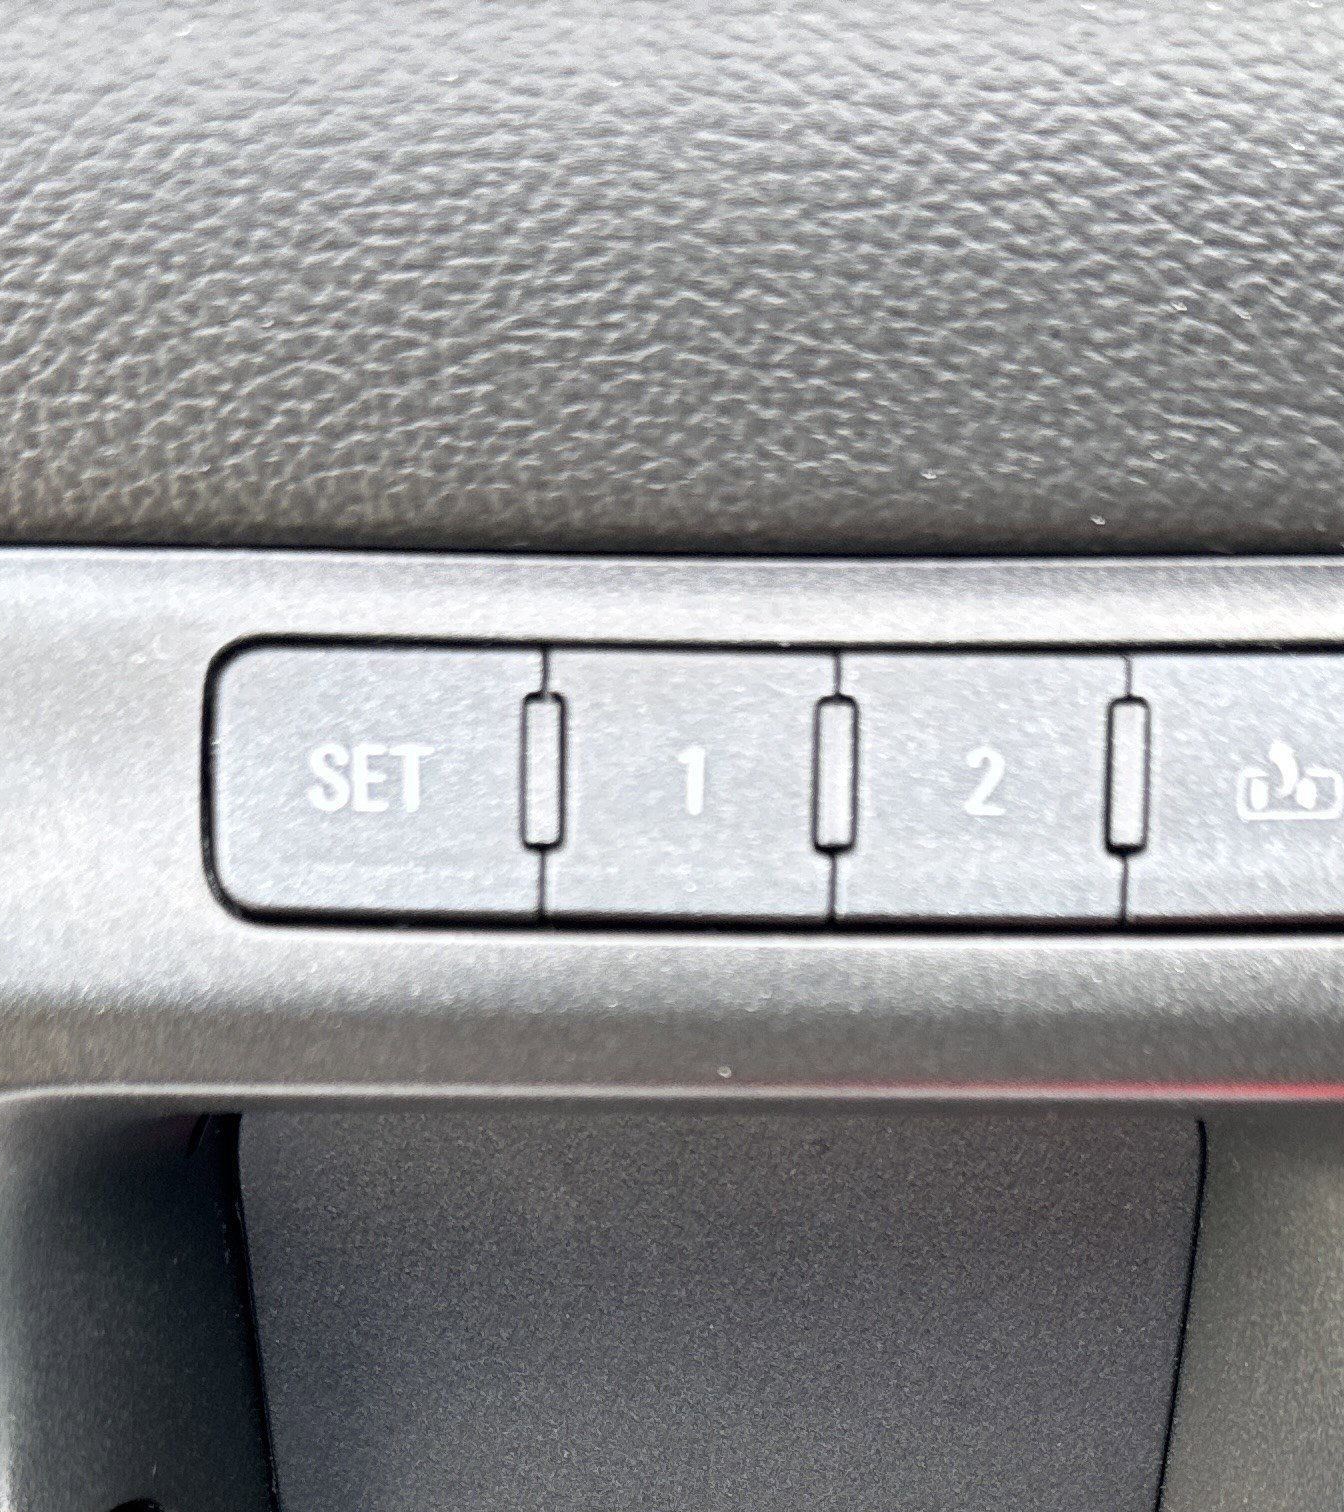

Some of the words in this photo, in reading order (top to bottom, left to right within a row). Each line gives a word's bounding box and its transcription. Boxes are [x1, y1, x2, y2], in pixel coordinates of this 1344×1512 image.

[306, 743, 435, 813] SET
[677, 745, 706, 815] 1
[964, 746, 1006, 816] 2
